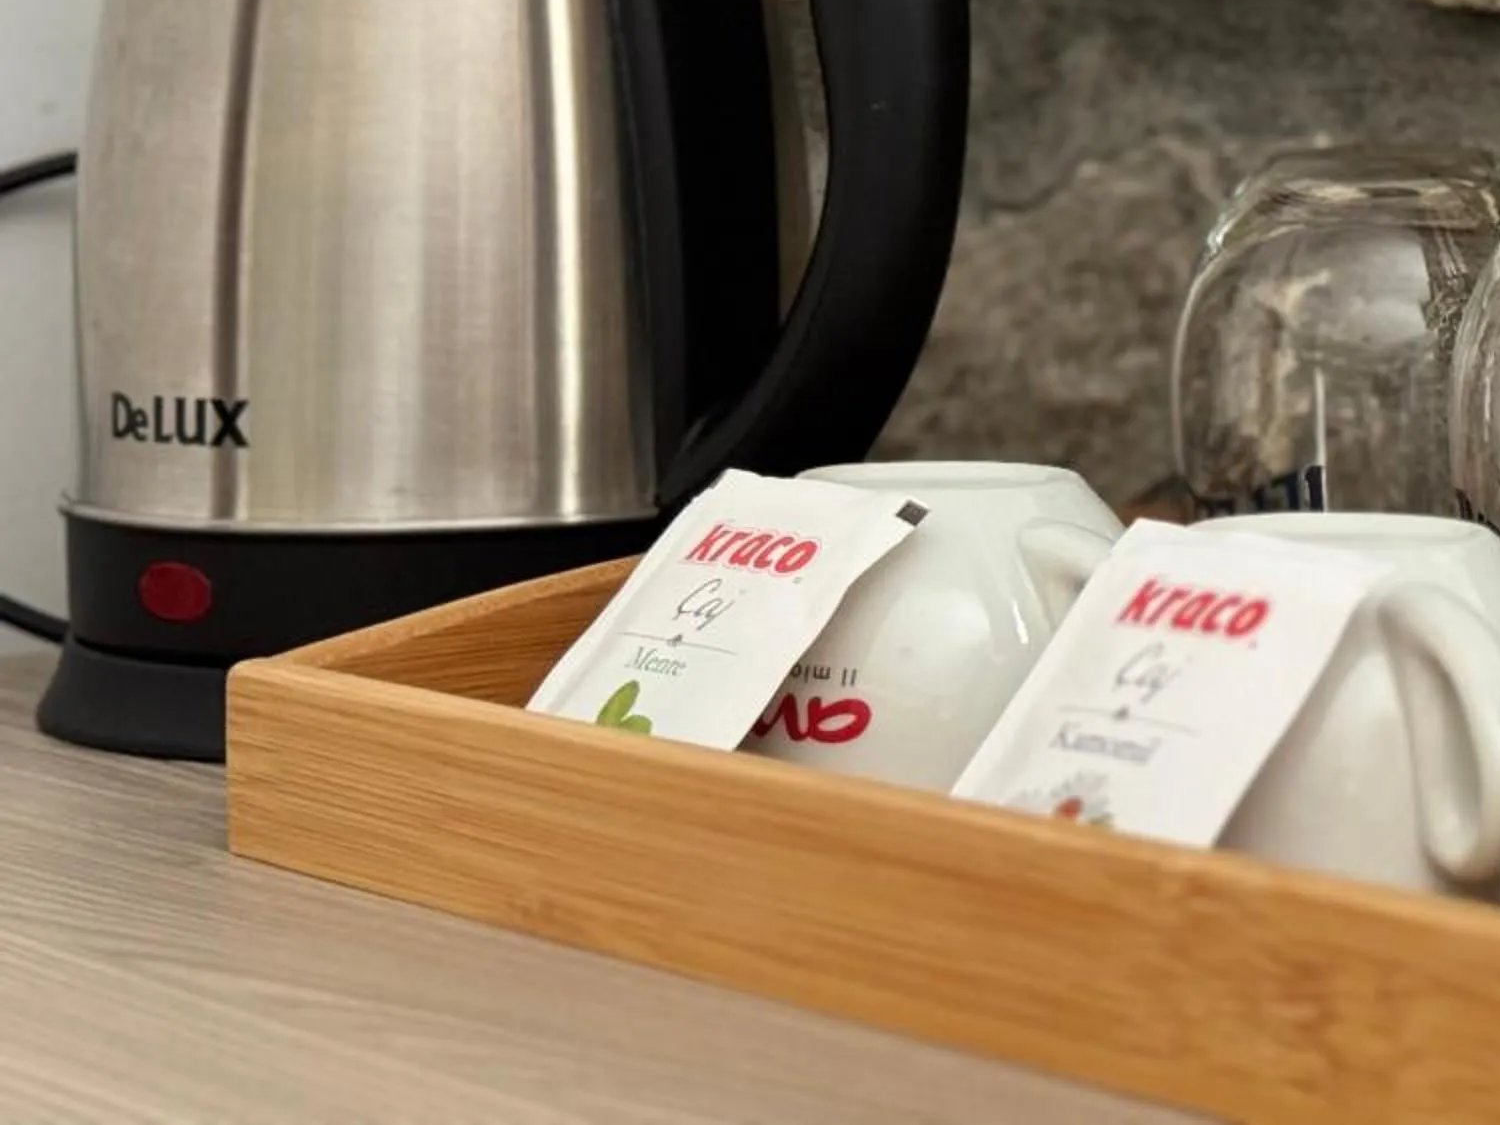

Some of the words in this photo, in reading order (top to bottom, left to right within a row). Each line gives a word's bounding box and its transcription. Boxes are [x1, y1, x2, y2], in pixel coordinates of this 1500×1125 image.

[111, 392, 250, 448] DeLUX
[684, 523, 820, 574] kraco
[1118, 579, 1272, 639] kraco
